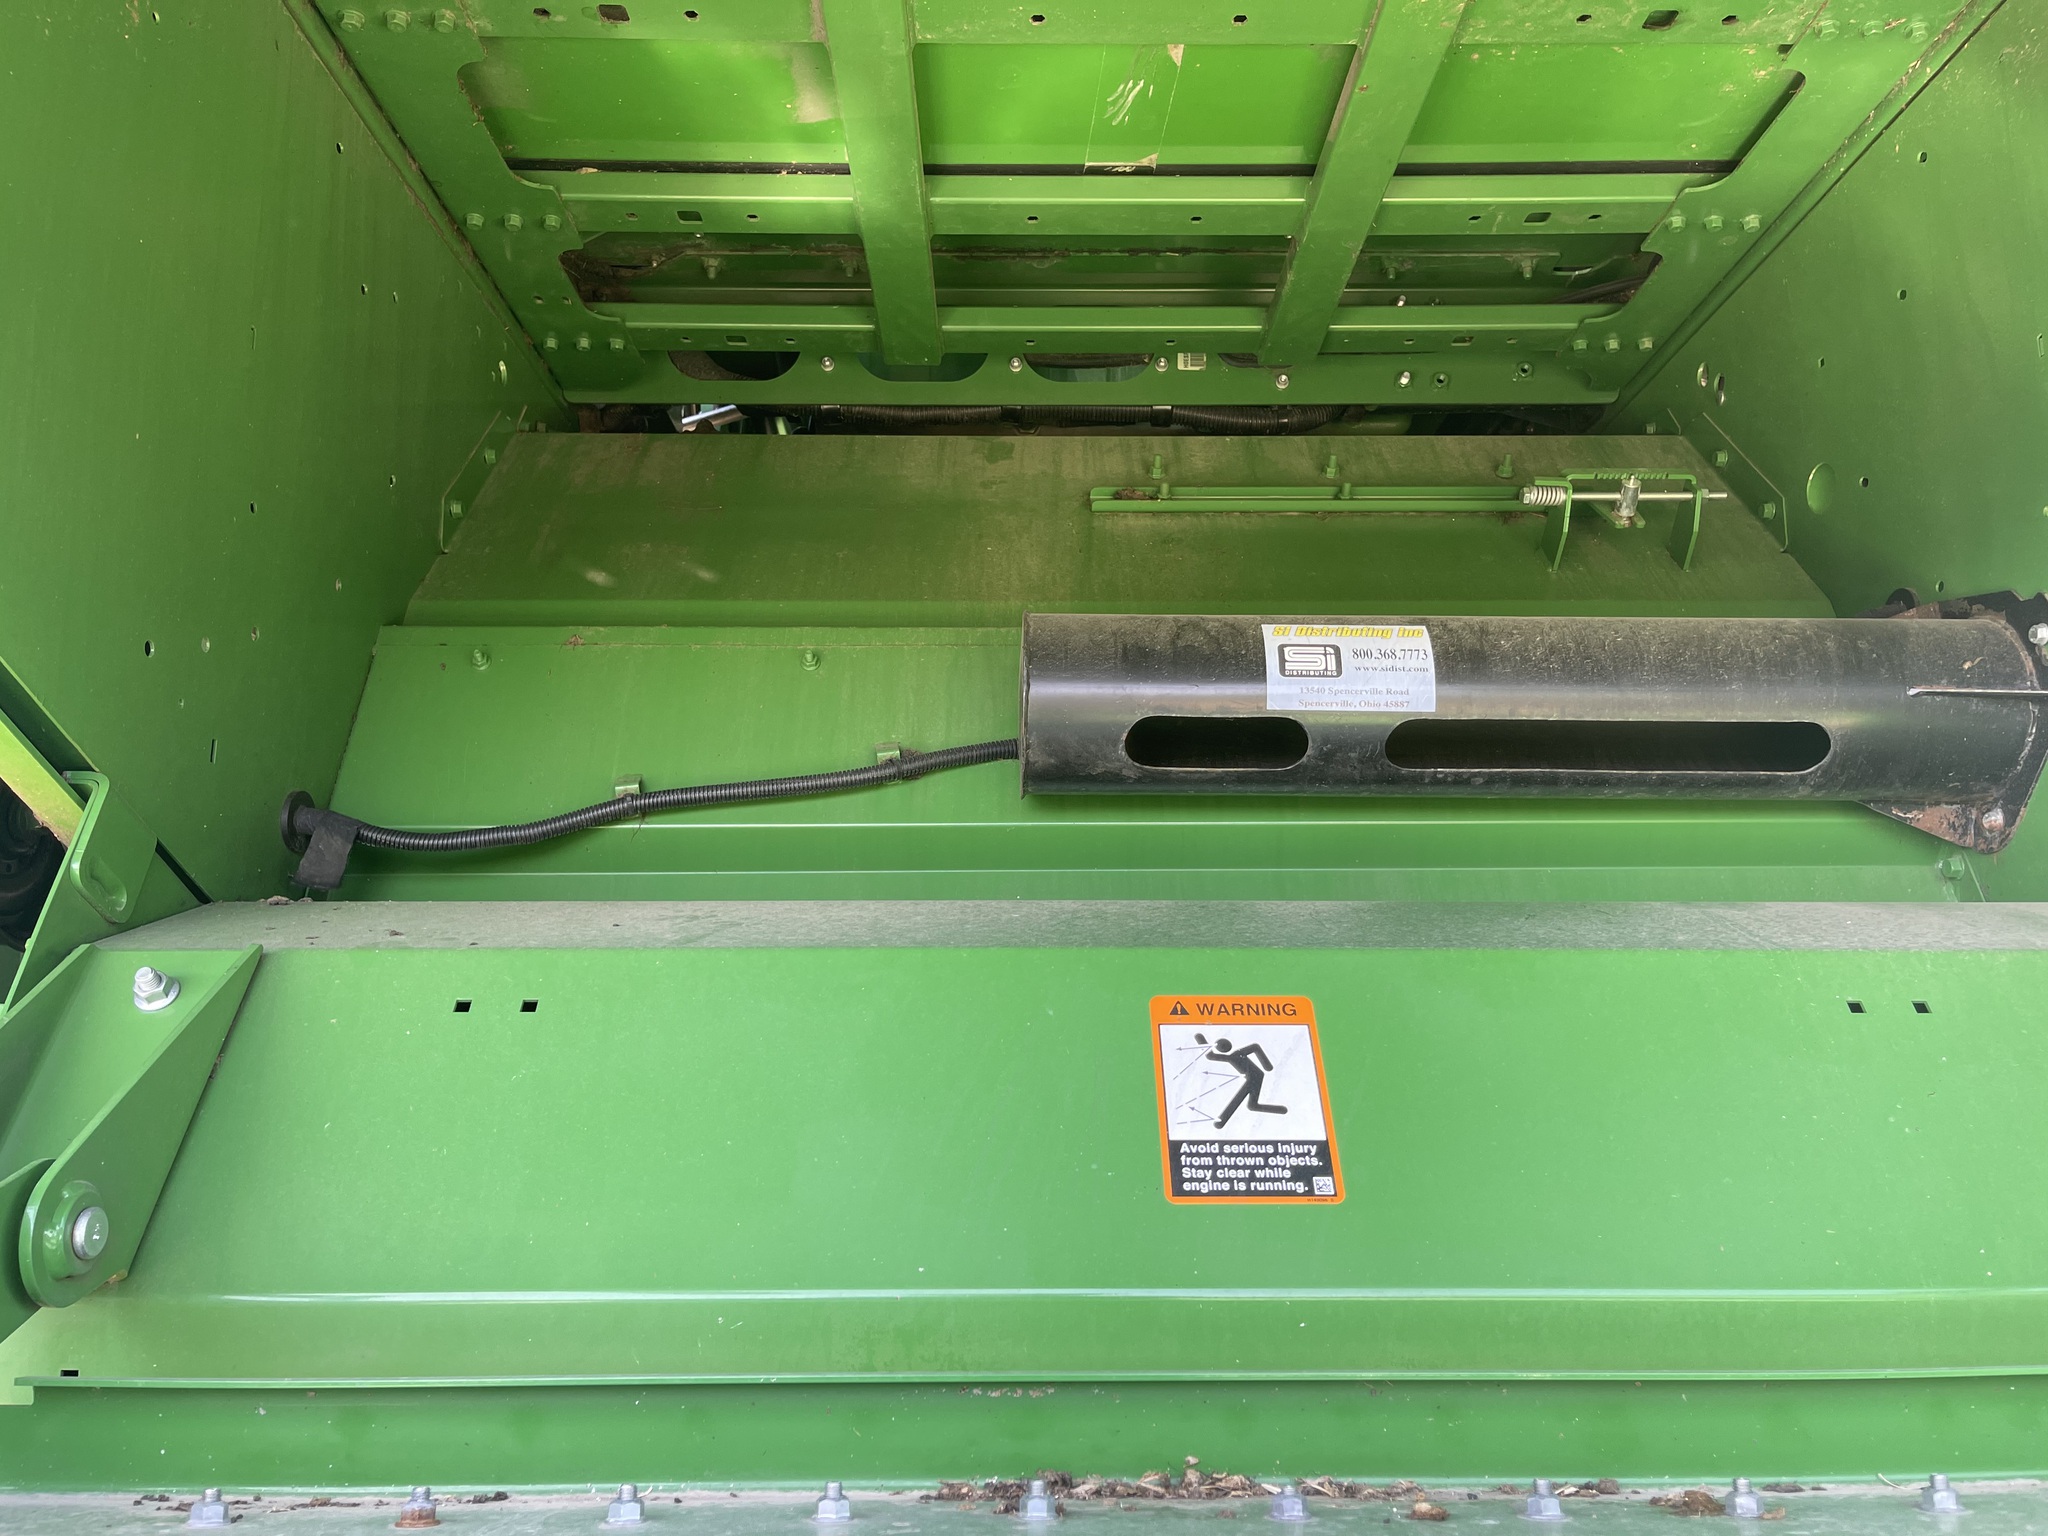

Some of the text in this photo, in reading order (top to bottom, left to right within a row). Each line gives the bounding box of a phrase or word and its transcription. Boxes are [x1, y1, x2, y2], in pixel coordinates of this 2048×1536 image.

[1294, 626, 1392, 639] Distributing
[1352, 648, 1428, 660] 800.368.7773
[1299, 687, 1410, 697] 13540 Spencerville Road
[1298, 699, 1410, 708] Spencerville, Ohio 45887
[1196, 1003, 1297, 1016] WARNING
[1180, 1143, 1318, 1157] Avoid serious injury
[1180, 1155, 1323, 1168] from thrown objects.
[1181, 1167, 1292, 1180] Stay clear while
[1182, 1180, 1309, 1193] engine is running.
